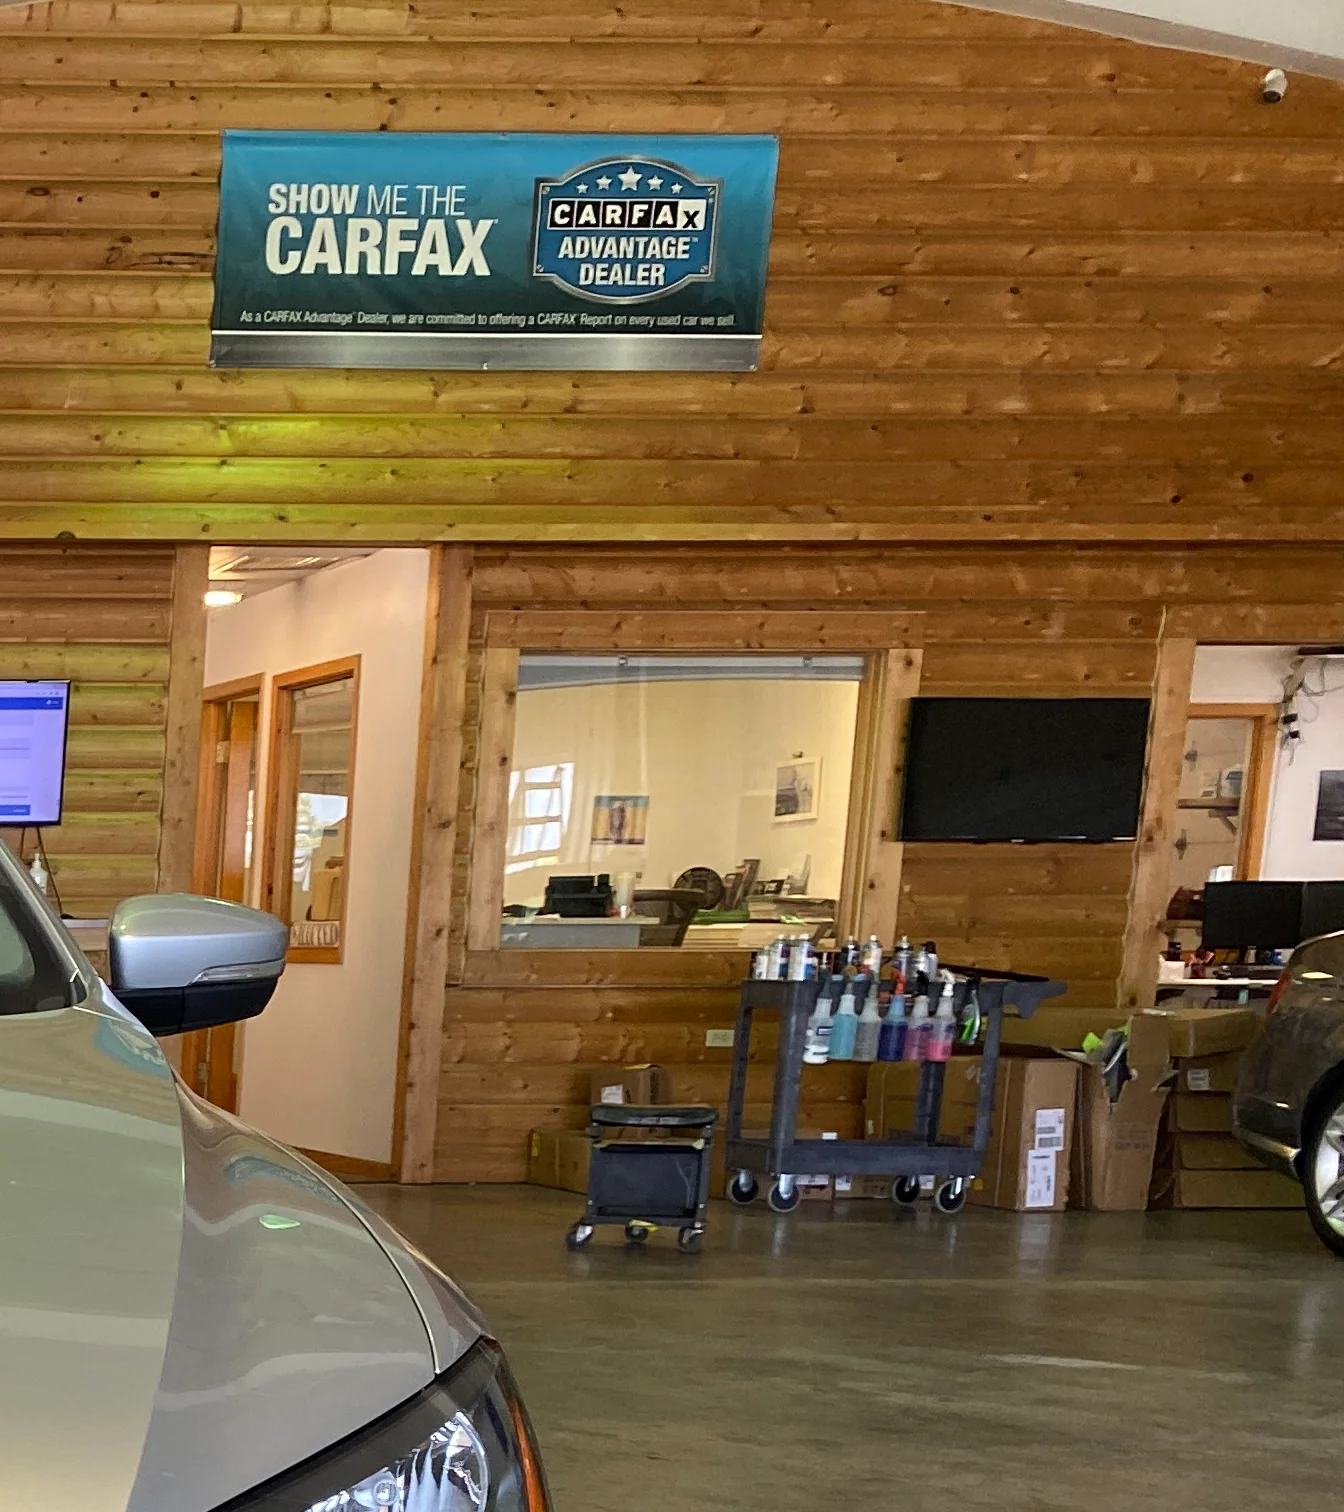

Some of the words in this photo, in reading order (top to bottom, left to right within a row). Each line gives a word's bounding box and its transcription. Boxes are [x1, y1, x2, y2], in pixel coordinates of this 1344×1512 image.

[267, 183, 359, 215] SHOW
[366, 184, 409, 215] ME
[416, 184, 466, 216] THE
[552, 203, 701, 229] CARFAX
[265, 215, 495, 277] CARFAX
[578, 262, 666, 286] DEALER
[240, 310, 253, 322] As
[254, 313, 262, 323] a
[263, 310, 302, 323] CARFAX
[357, 312, 390, 325] Dealer,
[392, 314, 406, 324] we
[408, 314, 424, 324] are
[426, 312, 476, 325] committed
[478, 313, 487, 325] to
[489, 312, 526, 328] offering
[537, 313, 575, 325] CARFAX
[580, 313, 612, 328] Report
[614, 316, 627, 325] on
[629, 316, 655, 328] every
[657, 314, 681, 326] used
[682, 316, 699, 326] car
[700, 317, 715, 326] we
